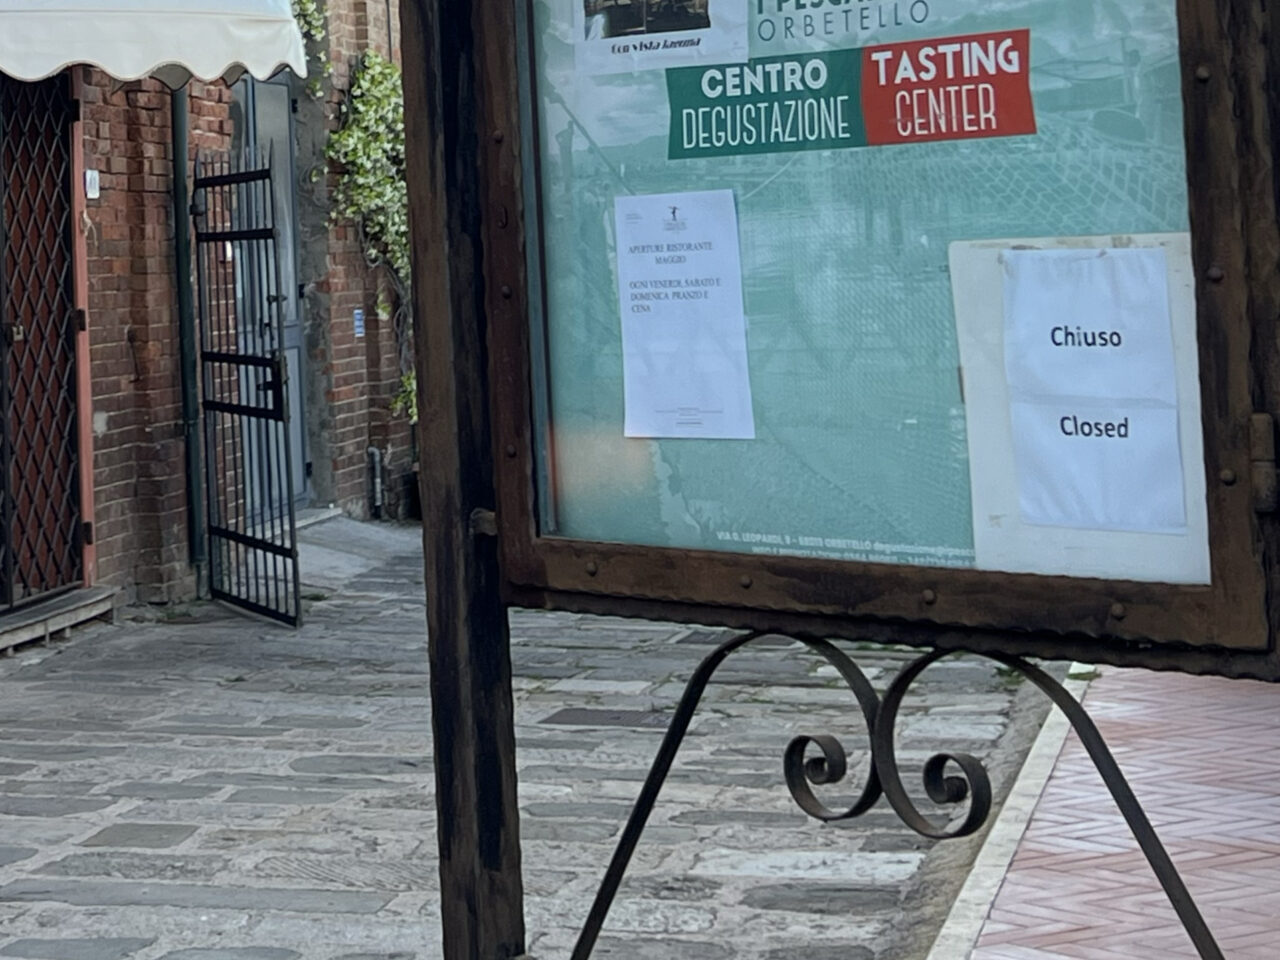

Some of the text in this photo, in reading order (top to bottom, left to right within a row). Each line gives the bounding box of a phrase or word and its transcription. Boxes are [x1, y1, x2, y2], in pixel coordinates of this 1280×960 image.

[757, 0, 929, 42] ORBETELLO
[871, 38, 1020, 86] TASTING
[701, 58, 828, 99] CENTRO
[682, 95, 851, 149] DEGUSTAZIONE
[895, 83, 998, 137] CENTER
[666, 241, 713, 253] RISTORANTE
[655, 255, 687, 265] MAGGIO
[630, 291, 670, 301] DOMENICA
[671, 290, 702, 301] PRANZO
[631, 304, 651, 313] CENA
[1050, 325, 1123, 348] Chiuso
[1059, 414, 1129, 439] Closed
